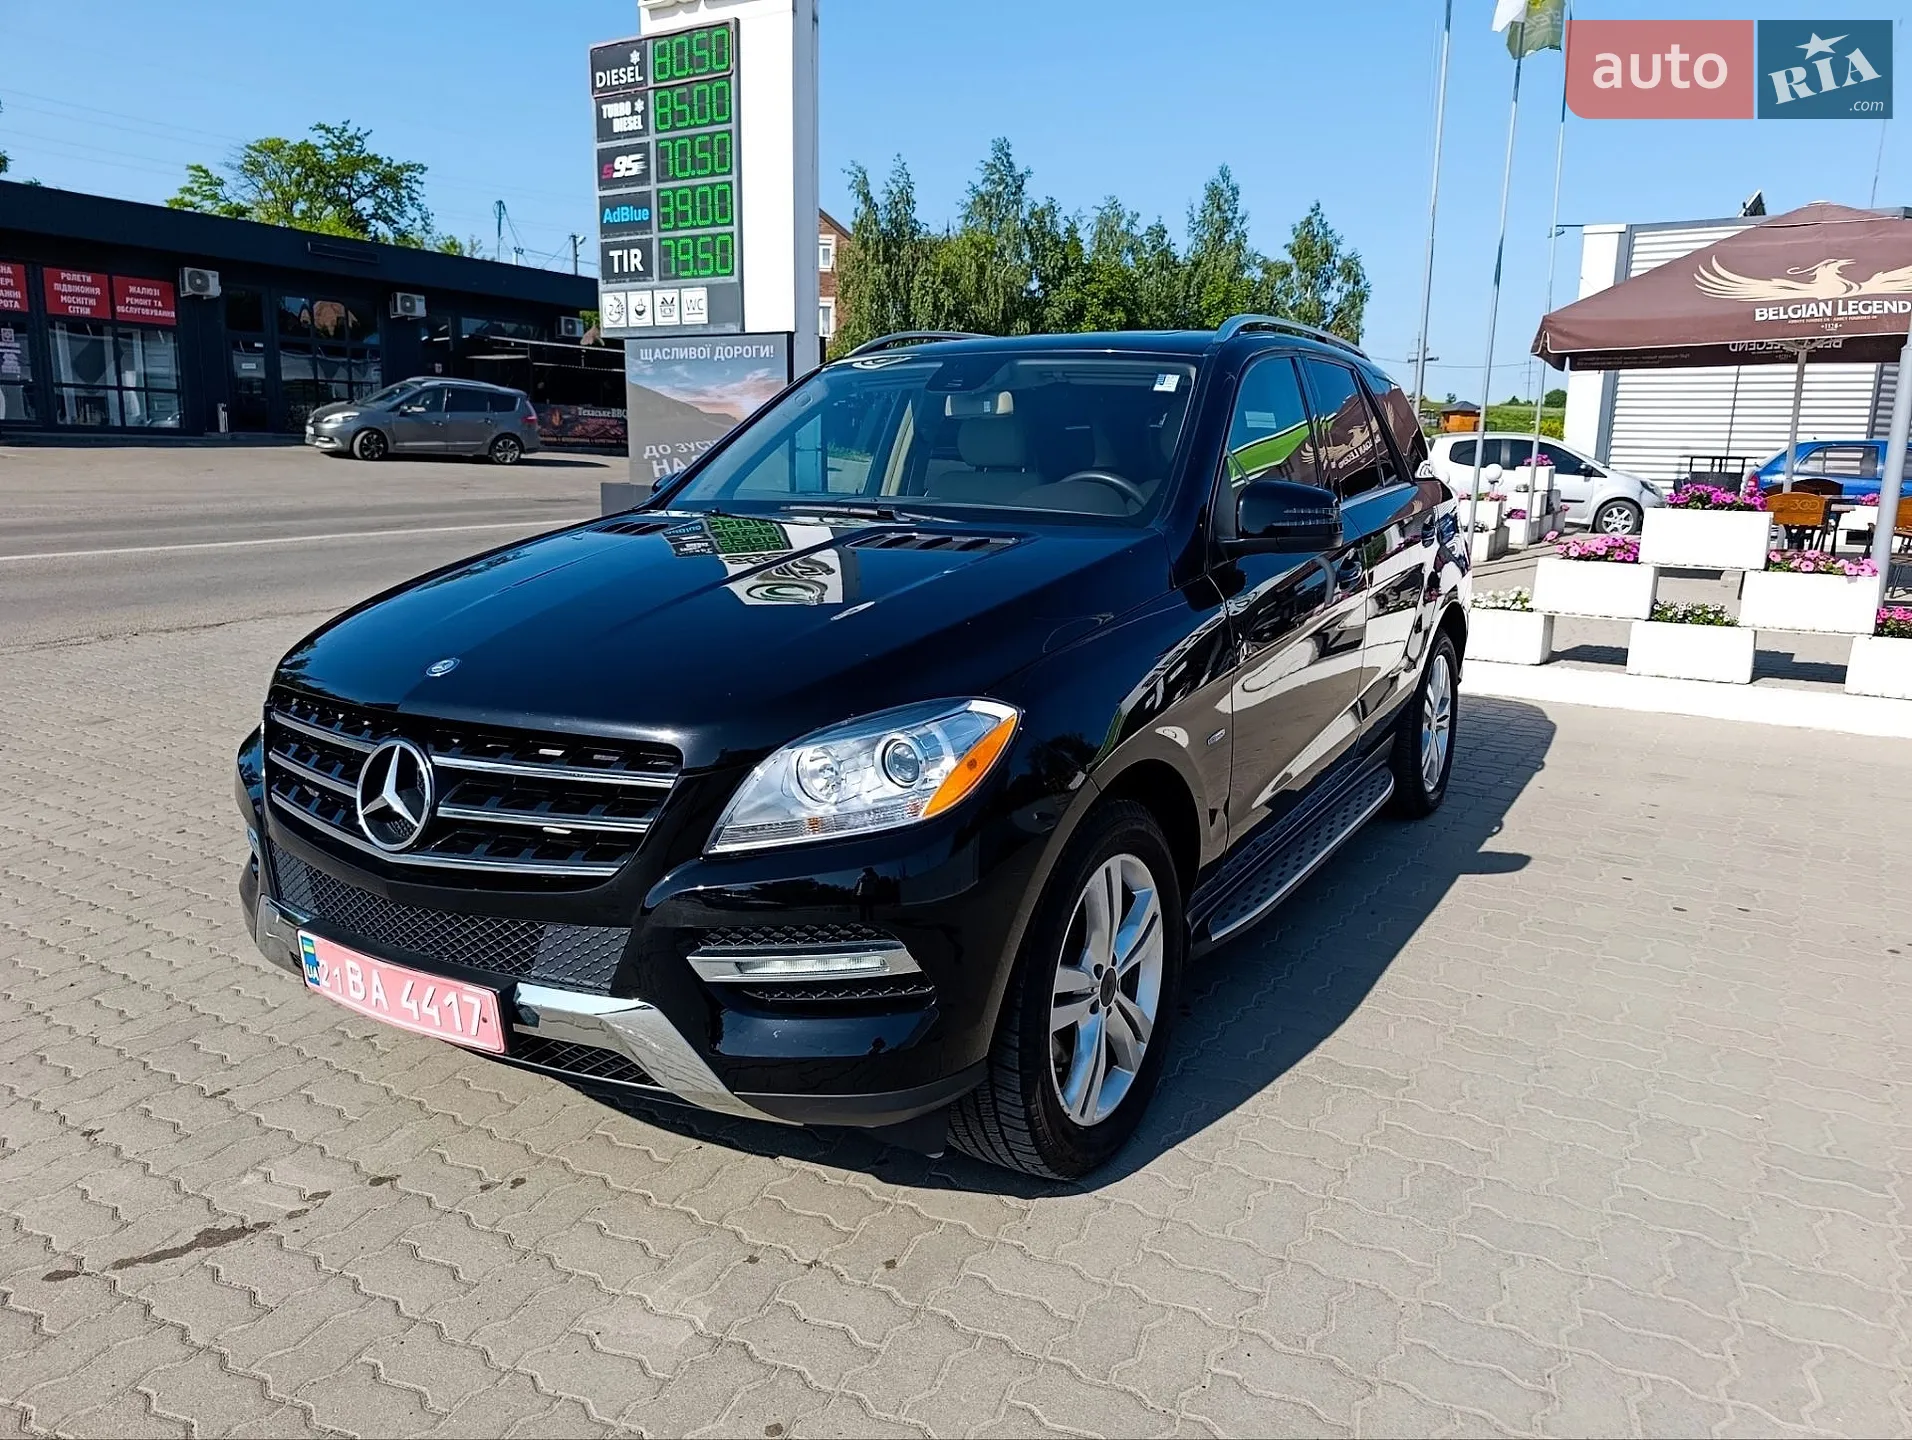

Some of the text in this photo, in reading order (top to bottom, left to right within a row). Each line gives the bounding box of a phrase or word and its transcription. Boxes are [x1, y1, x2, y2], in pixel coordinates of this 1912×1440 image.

[654, 28, 730, 80] 80.50
[595, 66, 644, 88] DIESEL
[601, 101, 632, 119] TURBO
[655, 80, 731, 130] 85.00
[612, 115, 644, 133] DIESEL
[658, 132, 731, 178] 70.50
[603, 184, 732, 230] AdBlue 39.00
[609, 234, 734, 278] TIR 79.50
[686, 298, 704, 312] WC
[1754, 299, 1912, 321] BELGIAN LEGEND
[640, 344, 774, 363] ЩАСЛИВОЇ ДОРОГИ!
[643, 444, 671, 459] ДО
[652, 457, 688, 478] НА
[305, 963, 320, 981] UA
[400, 980, 482, 1037] 4417
